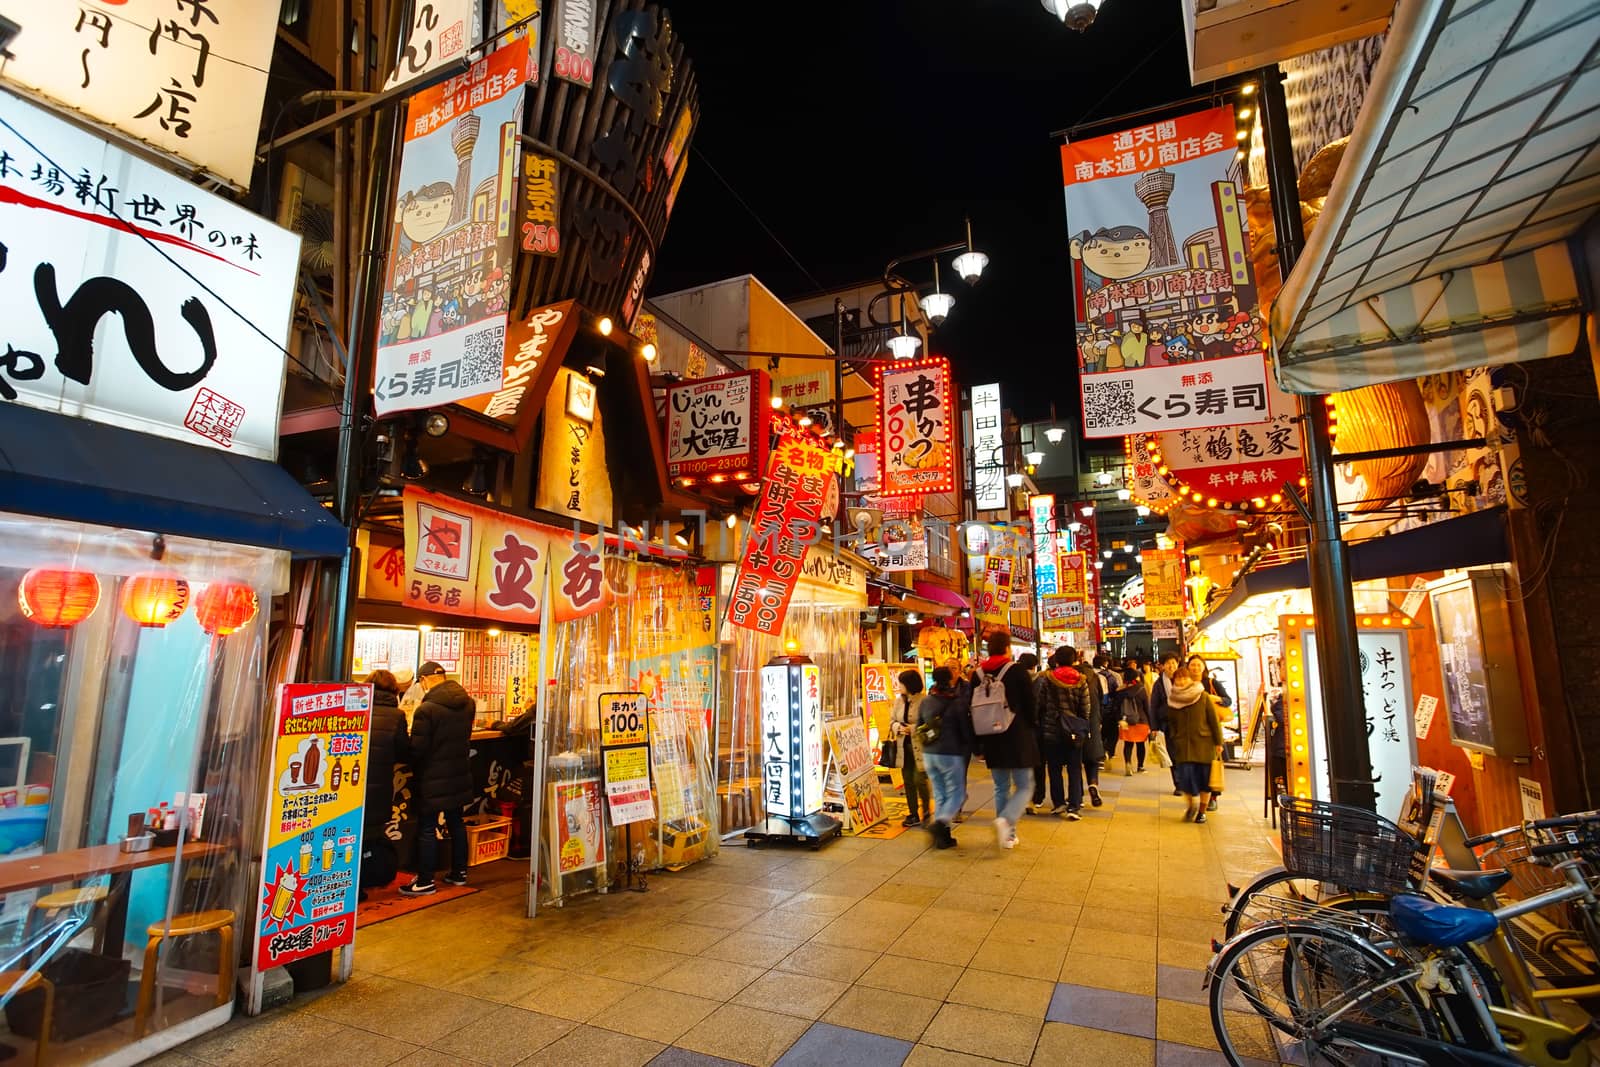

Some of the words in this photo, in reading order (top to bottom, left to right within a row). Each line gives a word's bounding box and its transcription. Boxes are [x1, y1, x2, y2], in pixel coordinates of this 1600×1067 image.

[556, 47, 593, 85] 300
[414, 66, 518, 136] 南本通り商店会
[1113, 119, 1176, 152] 通天閣
[1074, 131, 1224, 181] 南本通り商店会
[522, 221, 559, 253] 250
[1087, 271, 1233, 310] 南本通り商店街
[408, 348, 432, 366] 無添
[484, 308, 563, 418] やまと屋
[375, 360, 461, 401] くら寿司
[781, 380, 820, 398] 新世界
[1181, 371, 1214, 388] 無添
[191, 391, 218, 435] 本店
[673, 389, 721, 413] じゃん
[903, 374, 943, 460] 串かつ
[1137, 383, 1266, 421] くら寿司
[211, 402, 243, 447] 新世界
[691, 408, 741, 429] じゃん
[681, 427, 746, 458] 大西屋
[787, 447, 824, 471] 名物
[1204, 424, 1300, 462] 鶴亀家
[1208, 468, 1278, 488] 年中無休
[410, 580, 463, 607] 5号店
[866, 669, 885, 691] 24
[1375, 647, 1395, 691] 串かつ
[295, 694, 343, 713] 新世界名物
[479, 841, 505, 855] KIRIN
[270, 926, 313, 960] やまと屋
[315, 921, 346, 943] グループ
